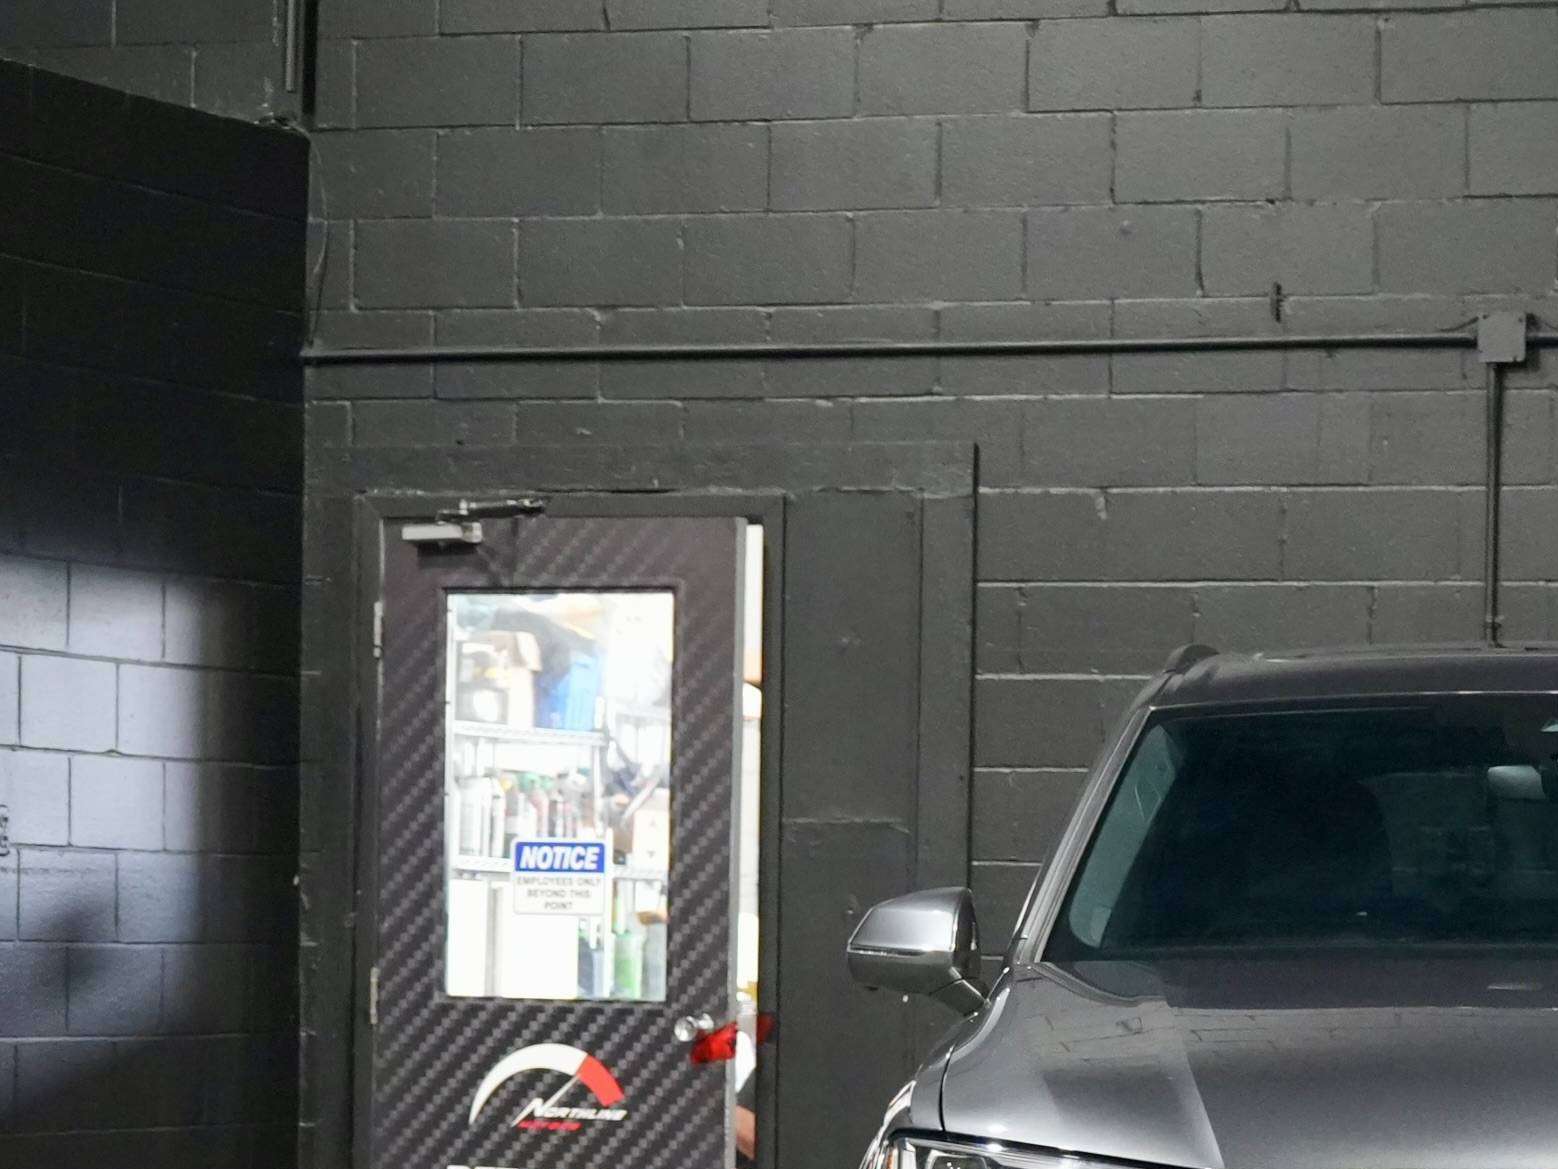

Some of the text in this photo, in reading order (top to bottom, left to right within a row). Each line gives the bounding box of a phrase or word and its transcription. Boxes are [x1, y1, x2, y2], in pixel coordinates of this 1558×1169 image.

[520, 845, 600, 870] NOTICE
[516, 876, 602, 886] EMPLOYEES ONLY
[527, 889, 590, 898] BEYOND THIS
[544, 901, 573, 909] POINT
